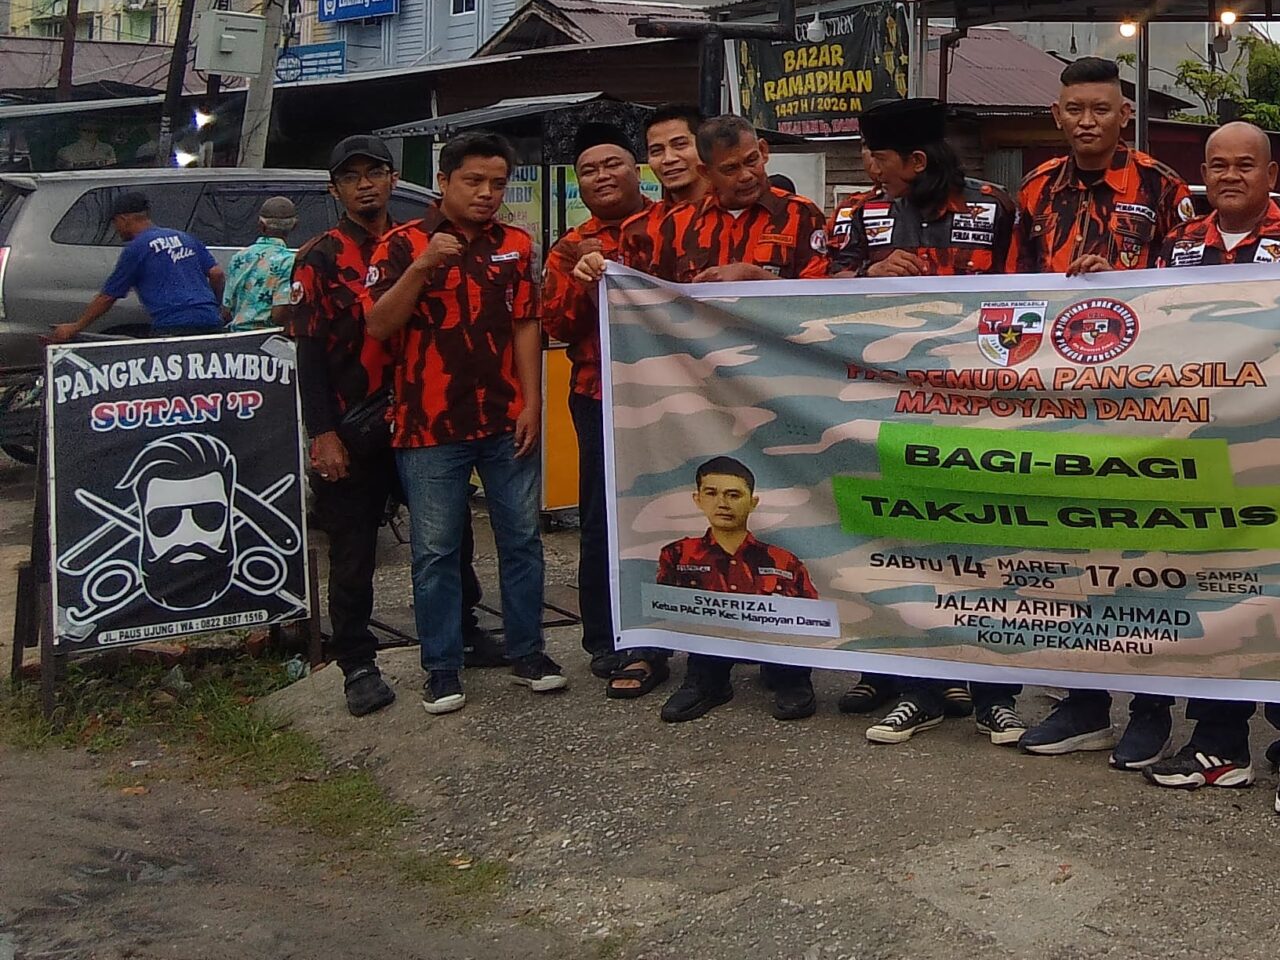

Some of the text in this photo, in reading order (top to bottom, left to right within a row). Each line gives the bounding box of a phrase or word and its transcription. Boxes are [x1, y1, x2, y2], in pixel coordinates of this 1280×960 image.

[784, 44, 844, 73] BAZAR
[764, 69, 873, 102] RAMADHAN
[775, 101, 800, 118] 1447
[817, 98, 847, 111] 2026
[149, 235, 183, 254] TEAM
[55, 353, 295, 404] PANGKAS RAMBUT
[906, 366, 1046, 392] PEMUDA
[1053, 361, 1268, 391] PANCASILA
[91, 393, 222, 431] SUTAN
[894, 390, 1212, 423] MARPOYAN DAMAI
[904, 443, 1199, 480] BAGI-BAGI
[861, 495, 1280, 530] TAKJIL GRATIS
[869, 552, 1259, 590] SABTU 14 MARET 17.00 SAMPAI
[1002, 574, 1263, 596] 2026 SELESAI
[652, 600, 831, 628] Ketua PAC PP Kec. Marpoyan Damai
[694, 595, 778, 613] SYAFRIZAL
[935, 594, 1191, 627] JALAN ARIFIN AHMAD
[119, 627, 141, 641] PAUS
[143, 624, 174, 637] UJUNG
[181, 620, 194, 632] WA
[200, 617, 221, 629] 0822
[953, 613, 1180, 642] KEC. MARPOYAN DAMAI
[977, 630, 1154, 656] KOTA PEKANBARU
